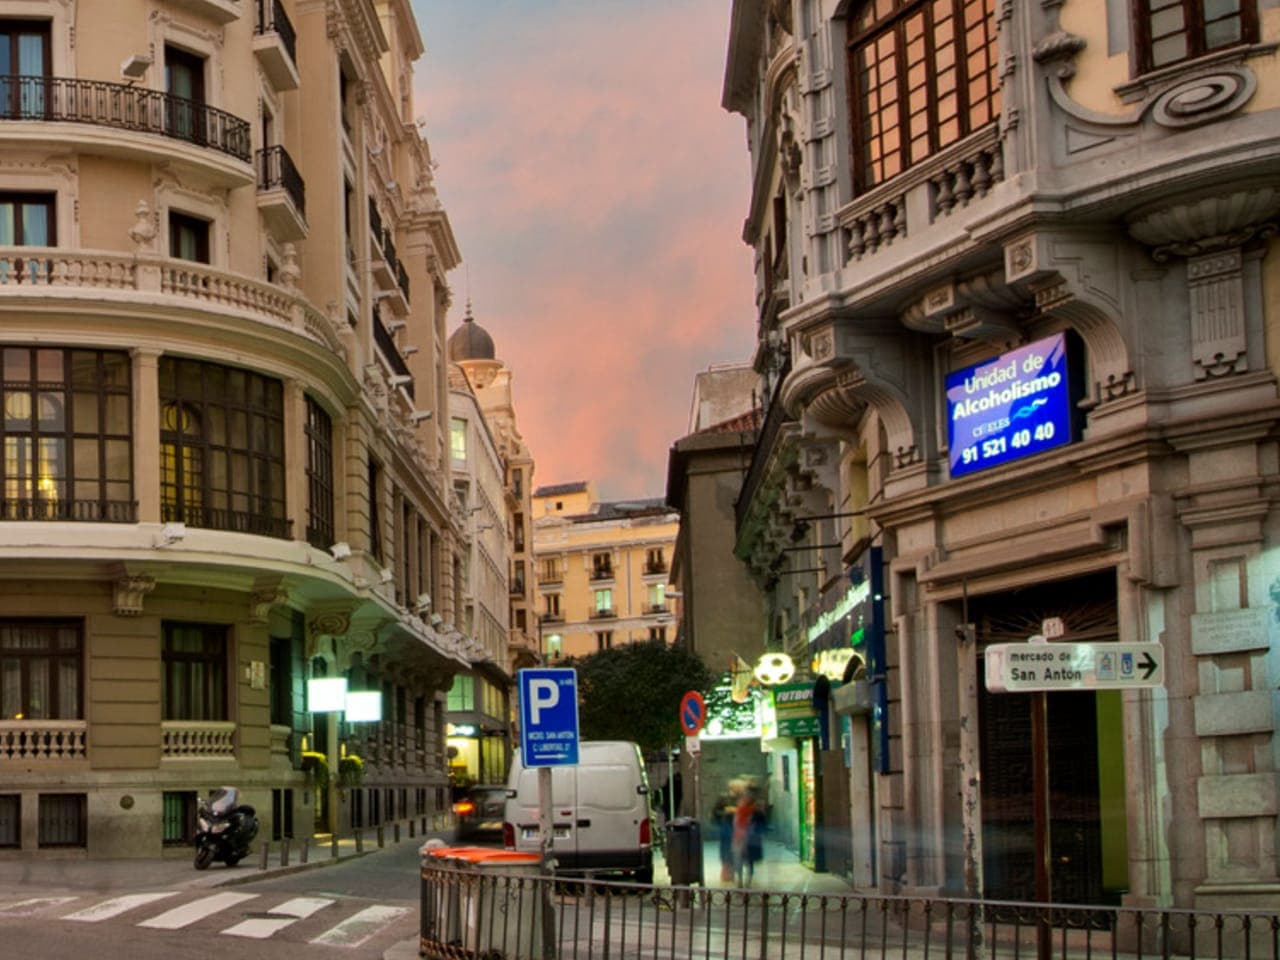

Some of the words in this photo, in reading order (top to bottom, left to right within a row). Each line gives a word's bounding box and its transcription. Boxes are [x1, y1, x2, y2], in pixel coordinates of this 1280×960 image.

[965, 359, 1016, 394] Unidad
[1023, 354, 1044, 373] de
[953, 372, 1061, 420] Alcoholismo
[962, 446, 978, 464] 91
[982, 437, 1006, 458] 521
[1011, 429, 1031, 448] 40
[1034, 422, 1055, 441] 40
[1010, 652, 1054, 662] mercado
[1059, 651, 1072, 662] de
[1011, 667, 1036, 681] San
[529, 678, 560, 725] P
